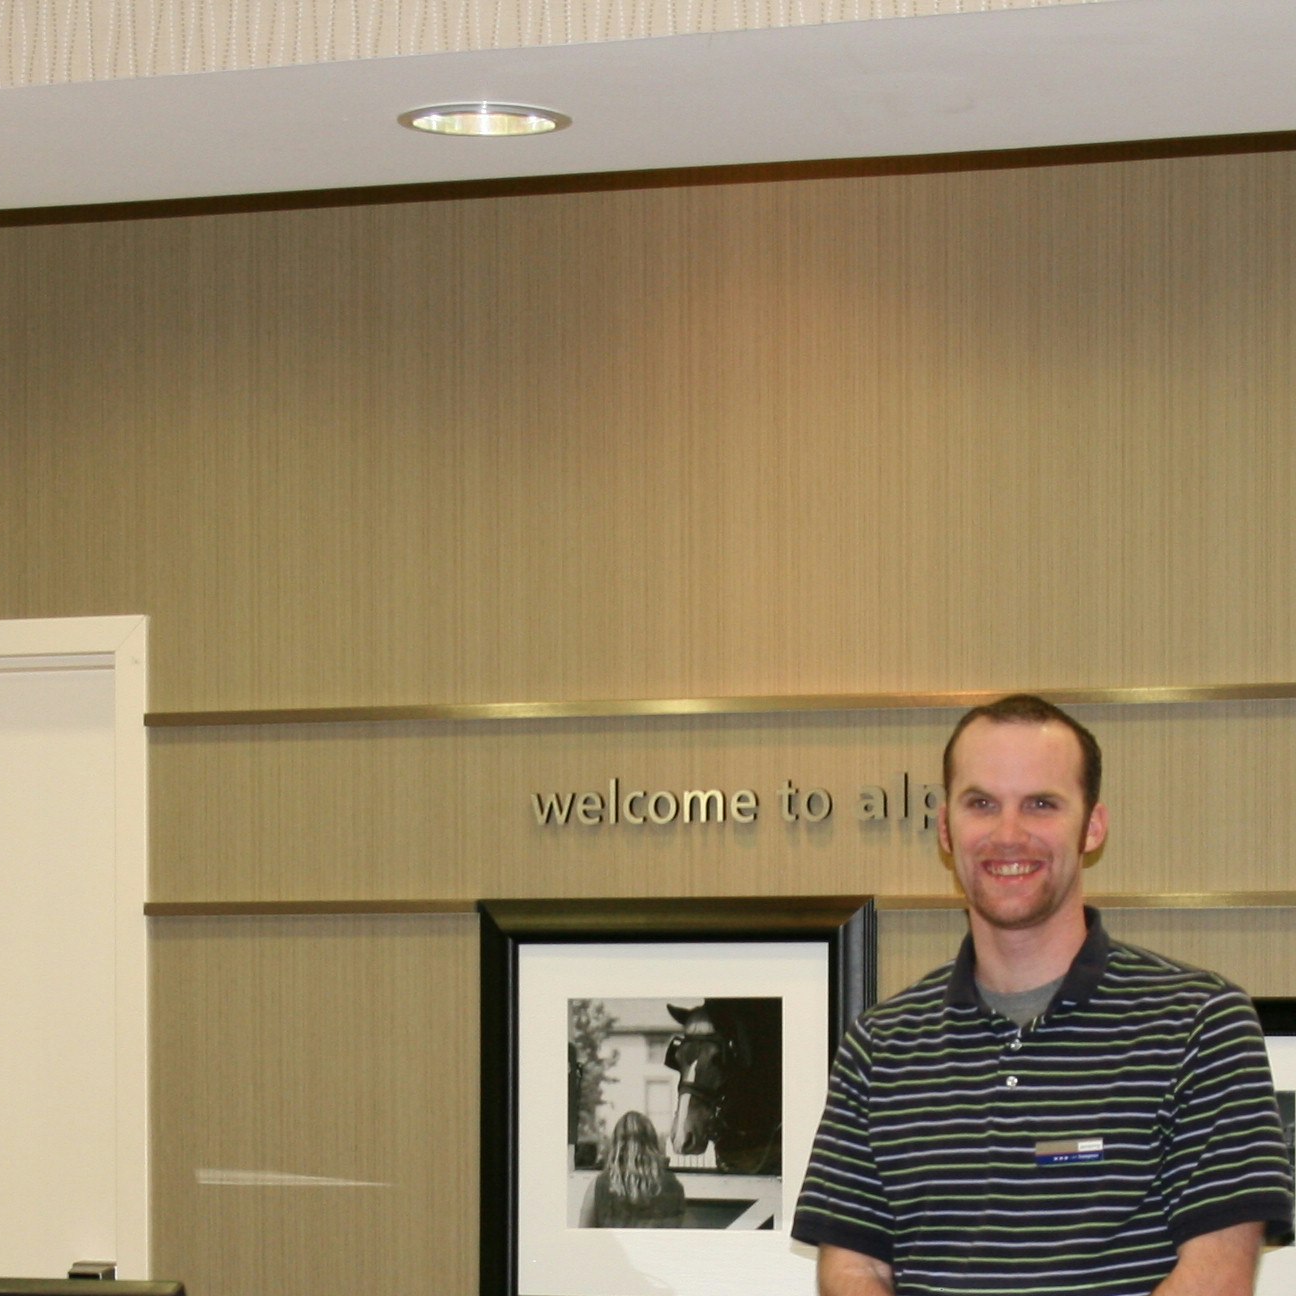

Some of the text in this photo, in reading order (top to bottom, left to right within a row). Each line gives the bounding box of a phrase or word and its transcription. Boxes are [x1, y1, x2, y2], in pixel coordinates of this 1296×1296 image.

[531, 771, 947, 832] welcome to alp
